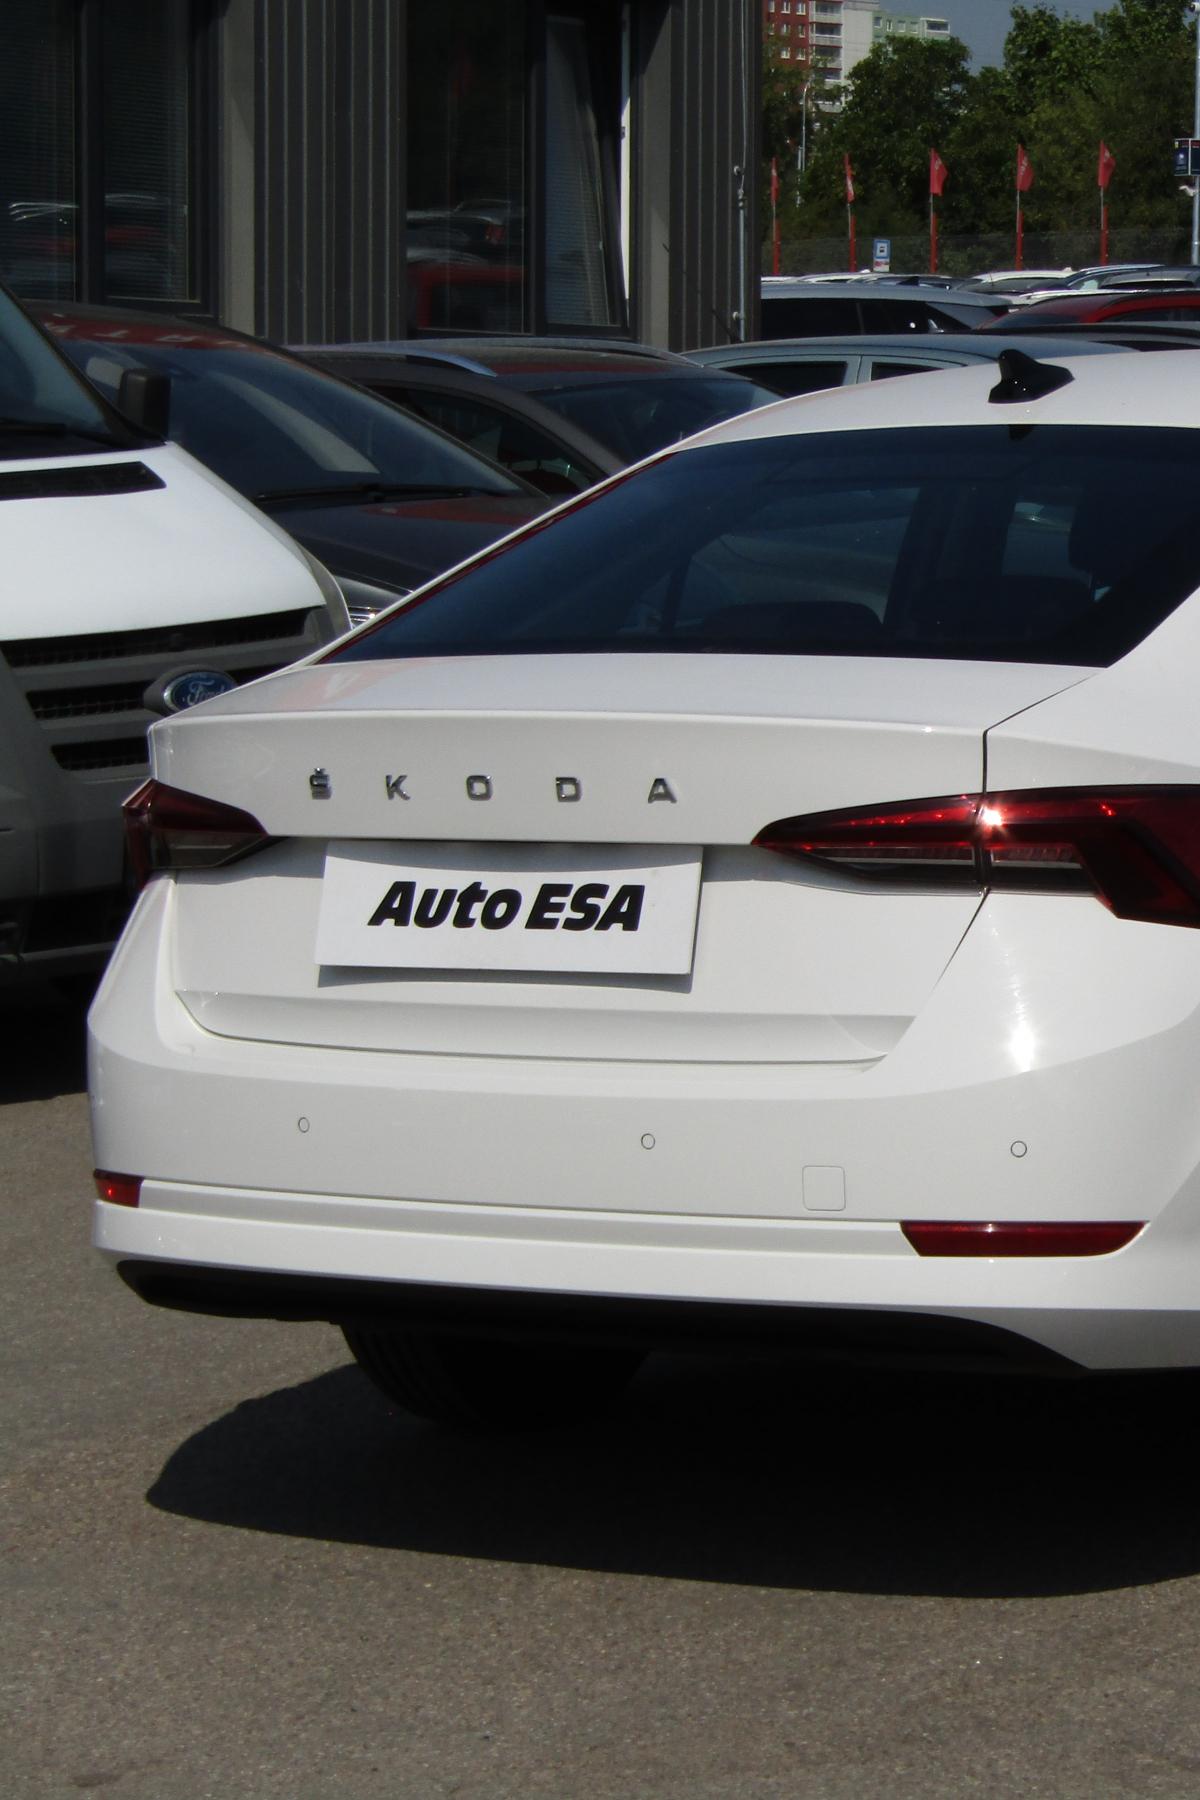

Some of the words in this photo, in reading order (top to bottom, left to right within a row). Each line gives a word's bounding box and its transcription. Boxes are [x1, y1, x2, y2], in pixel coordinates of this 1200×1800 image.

[309, 767, 678, 804] ŠKODA
[367, 881, 523, 930] Auto
[525, 883, 646, 932] ESA
